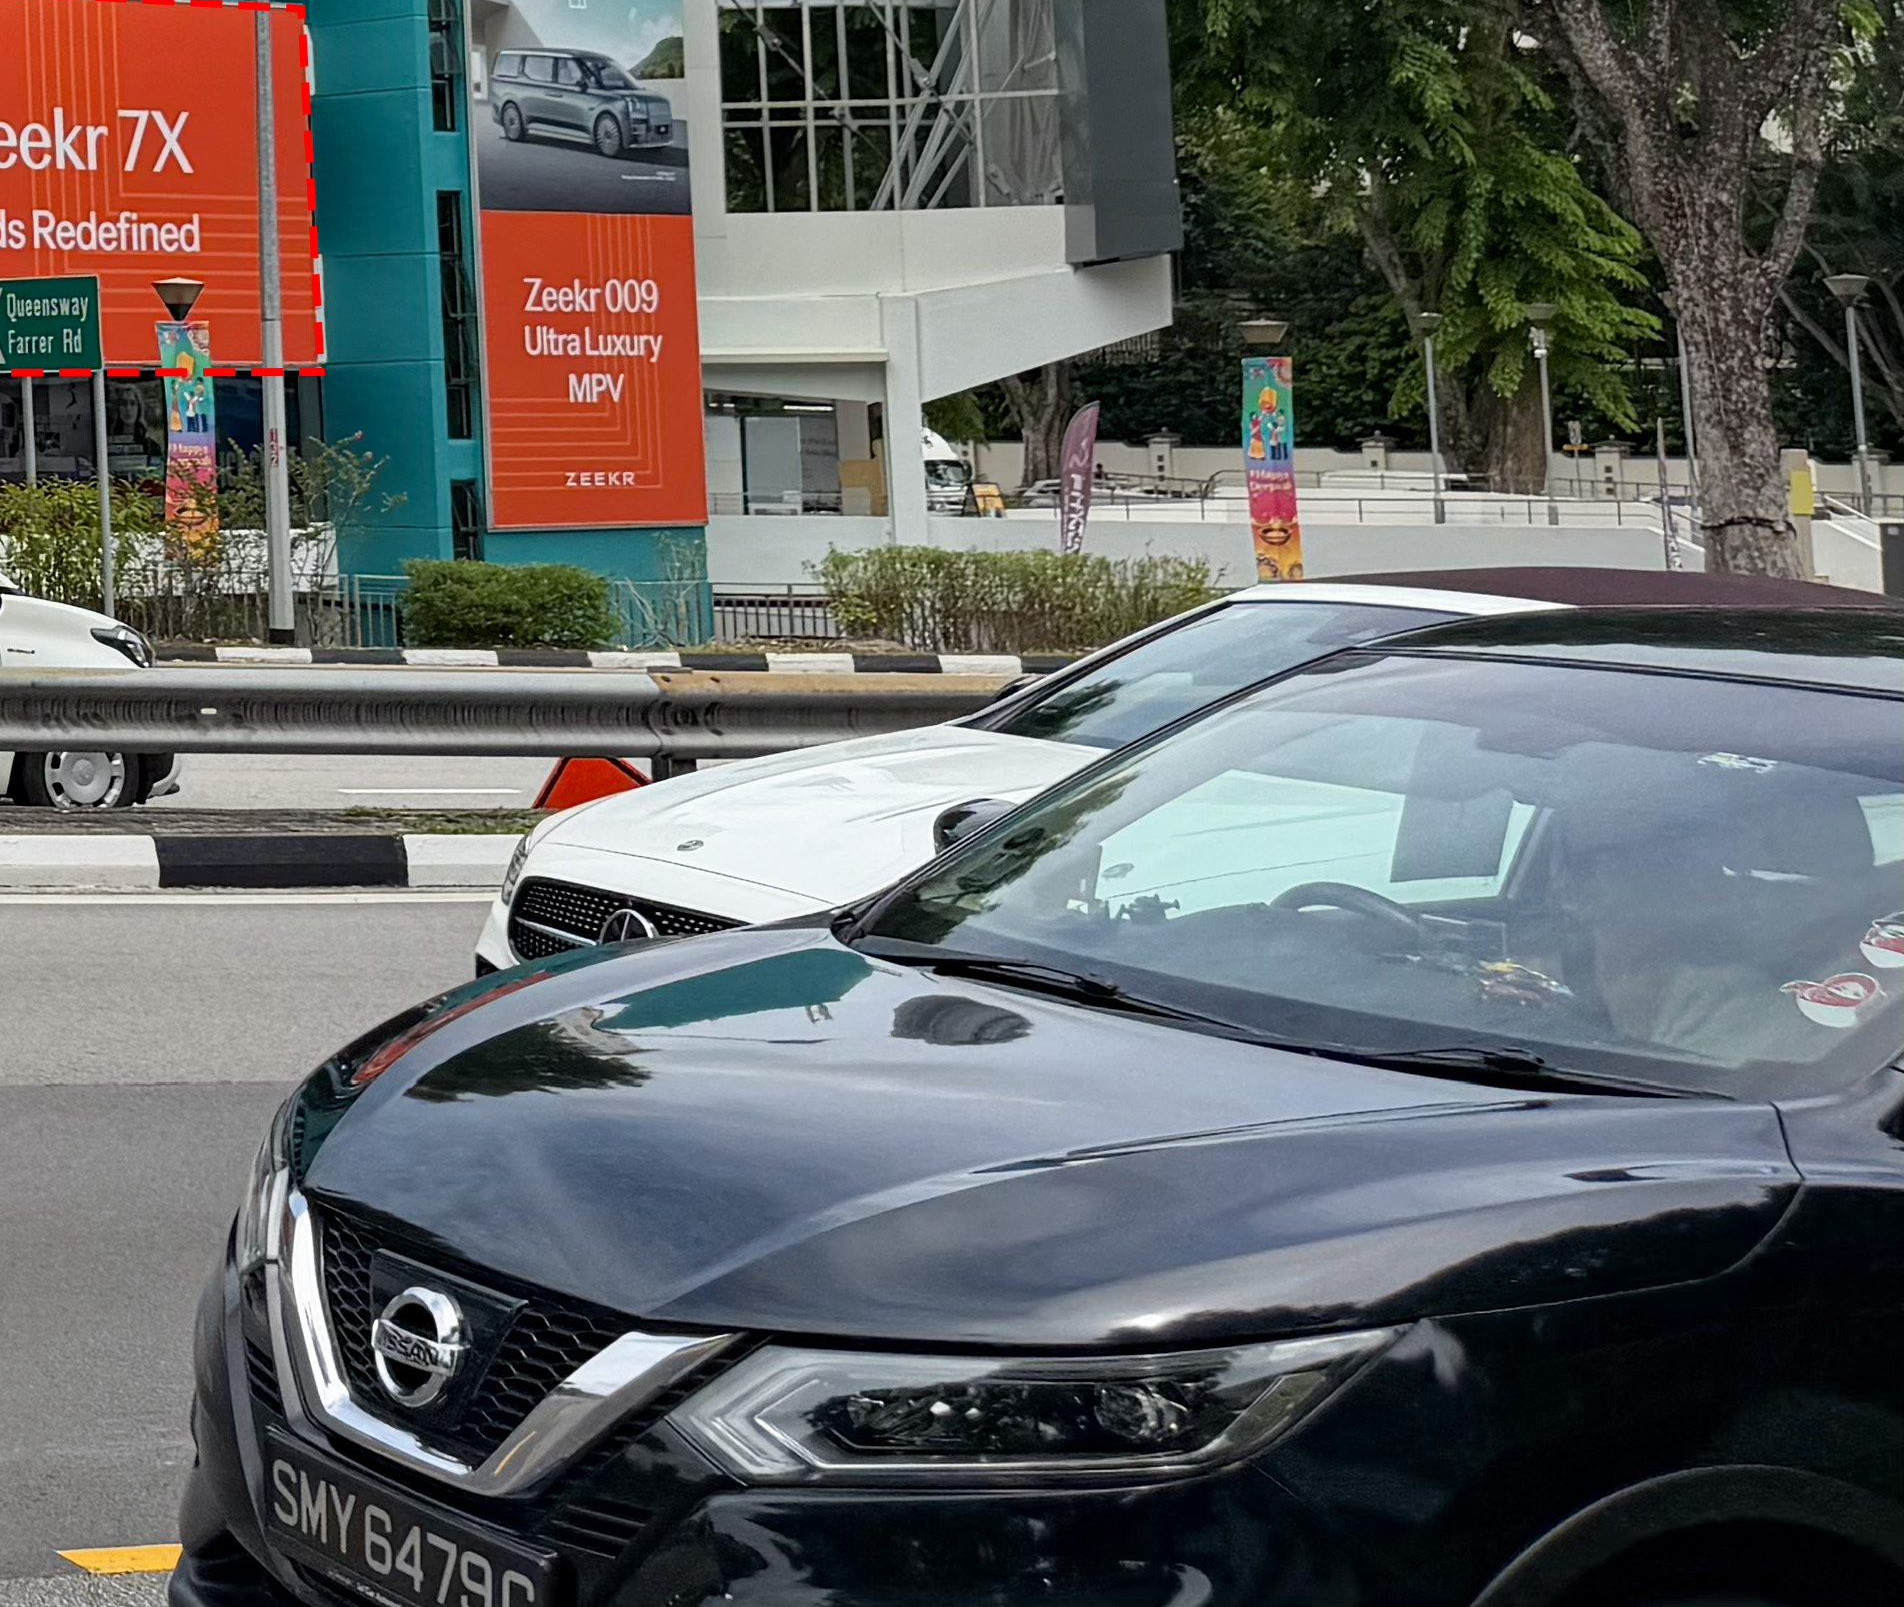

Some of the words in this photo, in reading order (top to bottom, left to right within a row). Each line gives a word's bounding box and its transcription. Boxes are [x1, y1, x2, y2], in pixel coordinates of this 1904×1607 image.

[117, 108, 194, 174] 7X
[32, 209, 201, 252] Redefined
[6, 293, 89, 322] Queensway
[523, 277, 601, 312] Zeekr
[605, 279, 659, 313] 009
[8, 330, 54, 354] Farrer
[63, 327, 83, 353] Rd
[524, 325, 580, 356] Ultra
[584, 326, 663, 362] Luxury
[568, 373, 624, 403] MPV
[565, 471, 636, 487] ZEEKR
